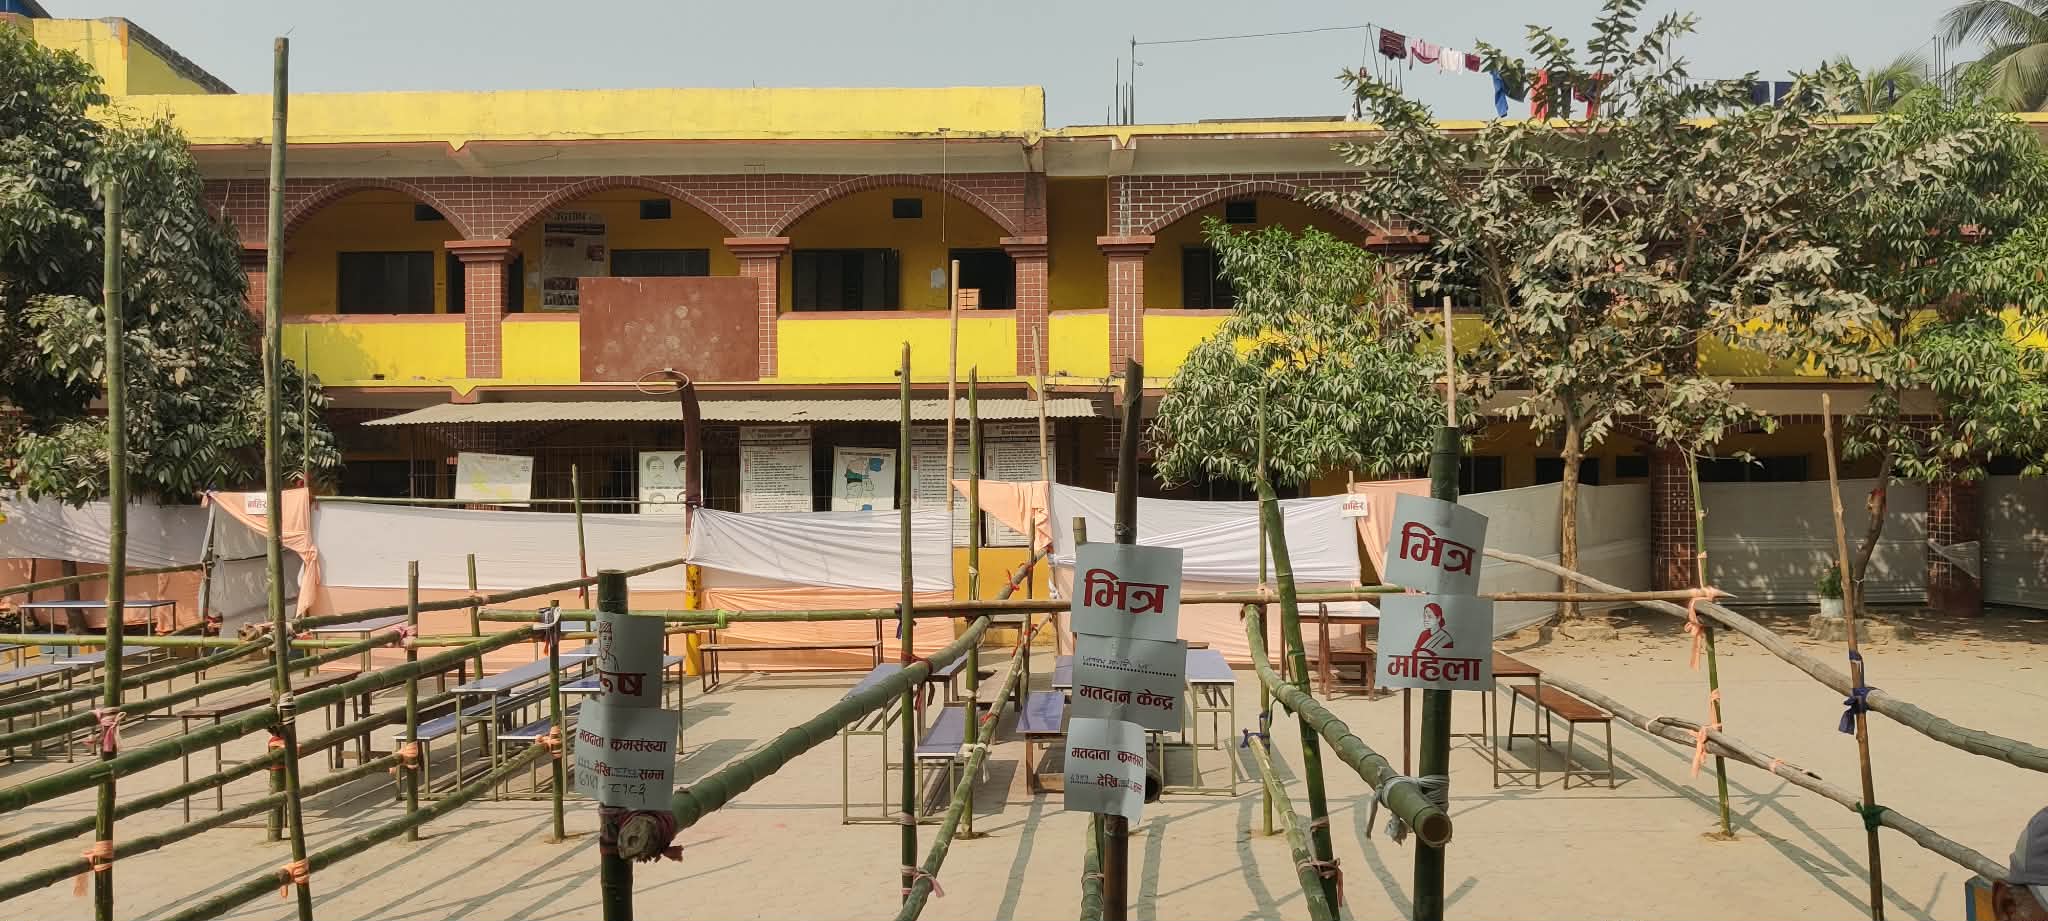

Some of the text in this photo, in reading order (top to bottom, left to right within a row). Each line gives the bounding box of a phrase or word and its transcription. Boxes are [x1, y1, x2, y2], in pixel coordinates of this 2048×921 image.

[1400, 521, 1476, 575] भित्र
[1083, 568, 1168, 614] भित्र
[1387, 648, 1483, 681] महिला
[599, 671, 647, 696] रुष
[1080, 684, 1176, 710] मतदान केन्द्र
[580, 729, 604, 748] मतदाता
[1072, 747, 1111, 761] मतदाता
[1096, 773, 1121, 788] देखि
